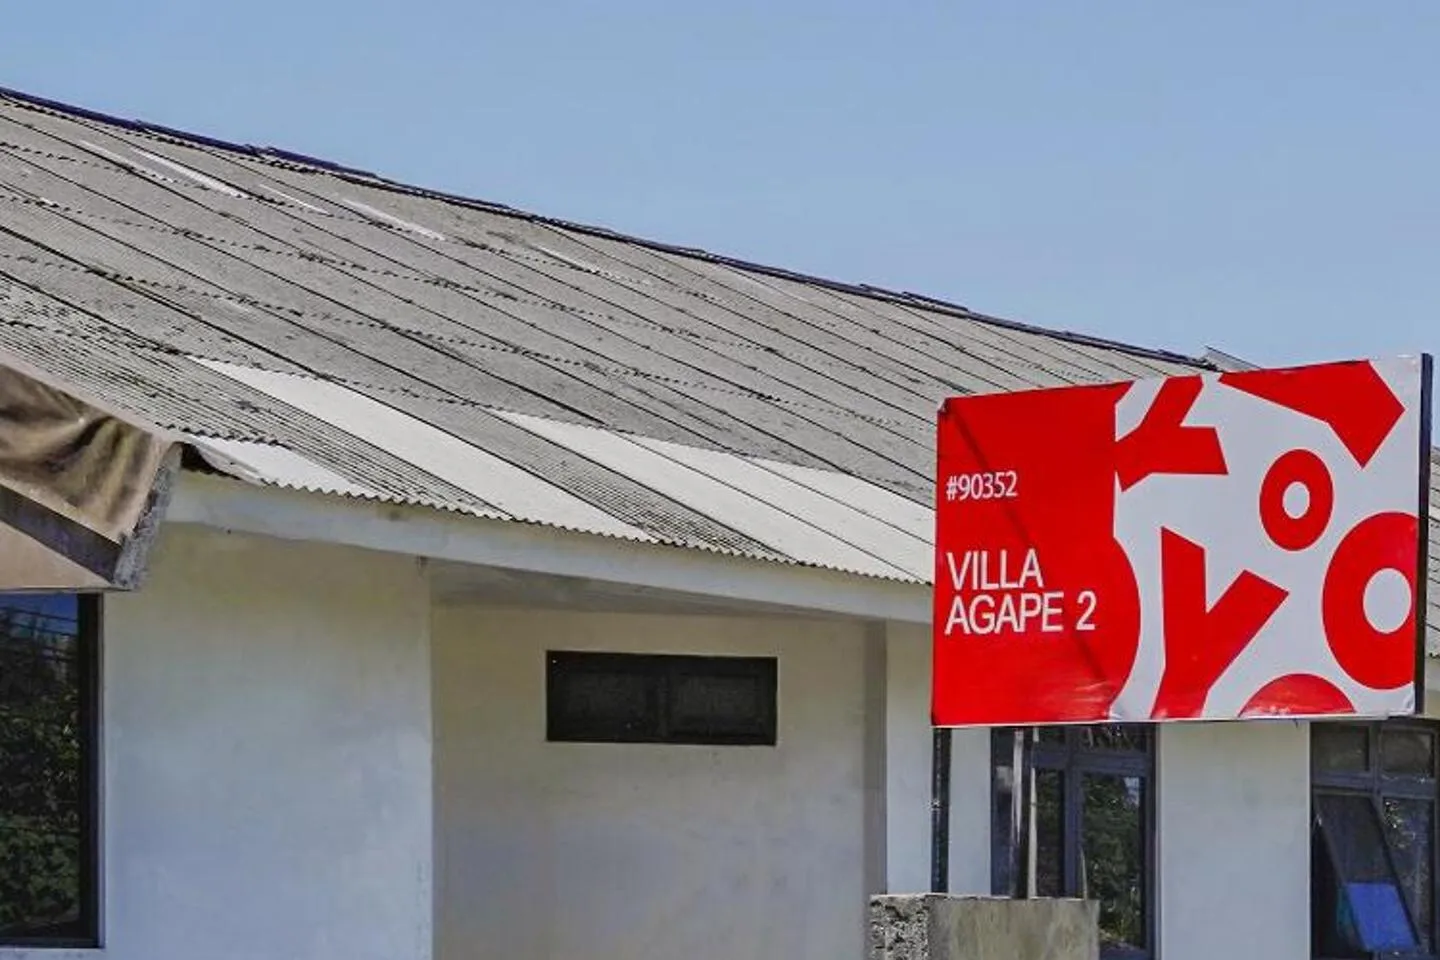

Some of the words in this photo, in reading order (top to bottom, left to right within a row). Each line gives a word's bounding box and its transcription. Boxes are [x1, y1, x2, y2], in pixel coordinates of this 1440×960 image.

[946, 470, 1018, 501] #90352
[946, 548, 1044, 590] VILLA
[944, 591, 1064, 635] AGAPE
[1075, 590, 1098, 631] 2
